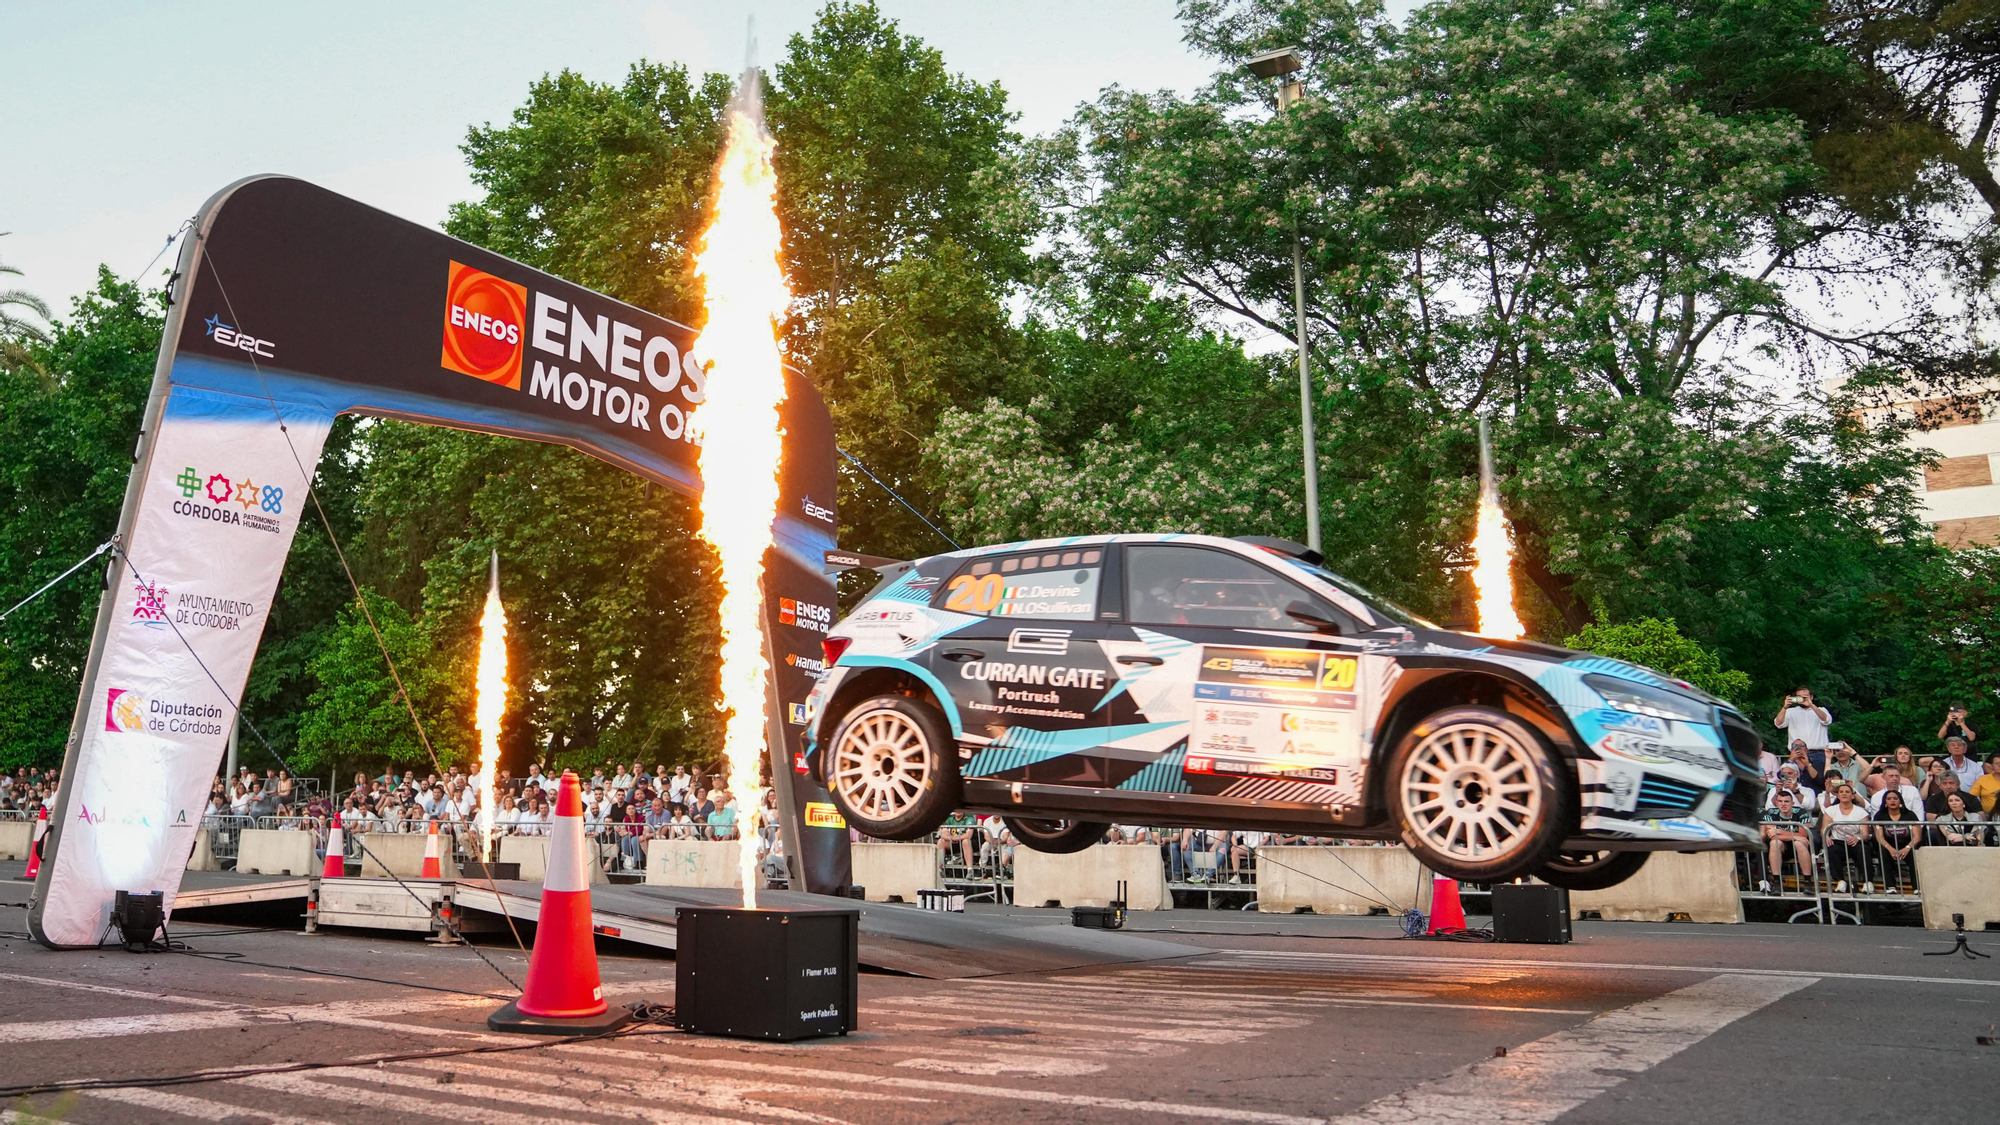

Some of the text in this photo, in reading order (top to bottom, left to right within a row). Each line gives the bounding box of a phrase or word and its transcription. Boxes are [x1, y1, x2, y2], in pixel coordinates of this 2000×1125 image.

[450, 304, 519, 345] ENEOS
[531, 291, 706, 403] ENEOS
[529, 360, 651, 431] MOTOR
[173, 500, 276, 525] CÓRDOBA PATRIMONIO
[243, 520, 280, 533] HUMANIDAD
[943, 573, 1005, 612] 20
[178, 593, 254, 617] AYUNTAMIENTO
[796, 600, 831, 623] ENEOS
[176, 609, 241, 630] DE CÓRDOBA
[796, 617, 829, 633] MOTOR OIL
[1202, 657, 1233, 671] 43
[1322, 657, 1358, 688] 20
[960, 661, 1106, 690] CURRAN GATE
[998, 687, 1060, 704] Portrush
[150, 699, 222, 719] Diputación
[968, 701, 1085, 720] Luxury Accommodation
[149, 718, 221, 735] de Córdoba
[1215, 761, 1247, 773] BRIAN
[823, 967, 837, 975] PLUS
[800, 1010, 816, 1021] Spark
